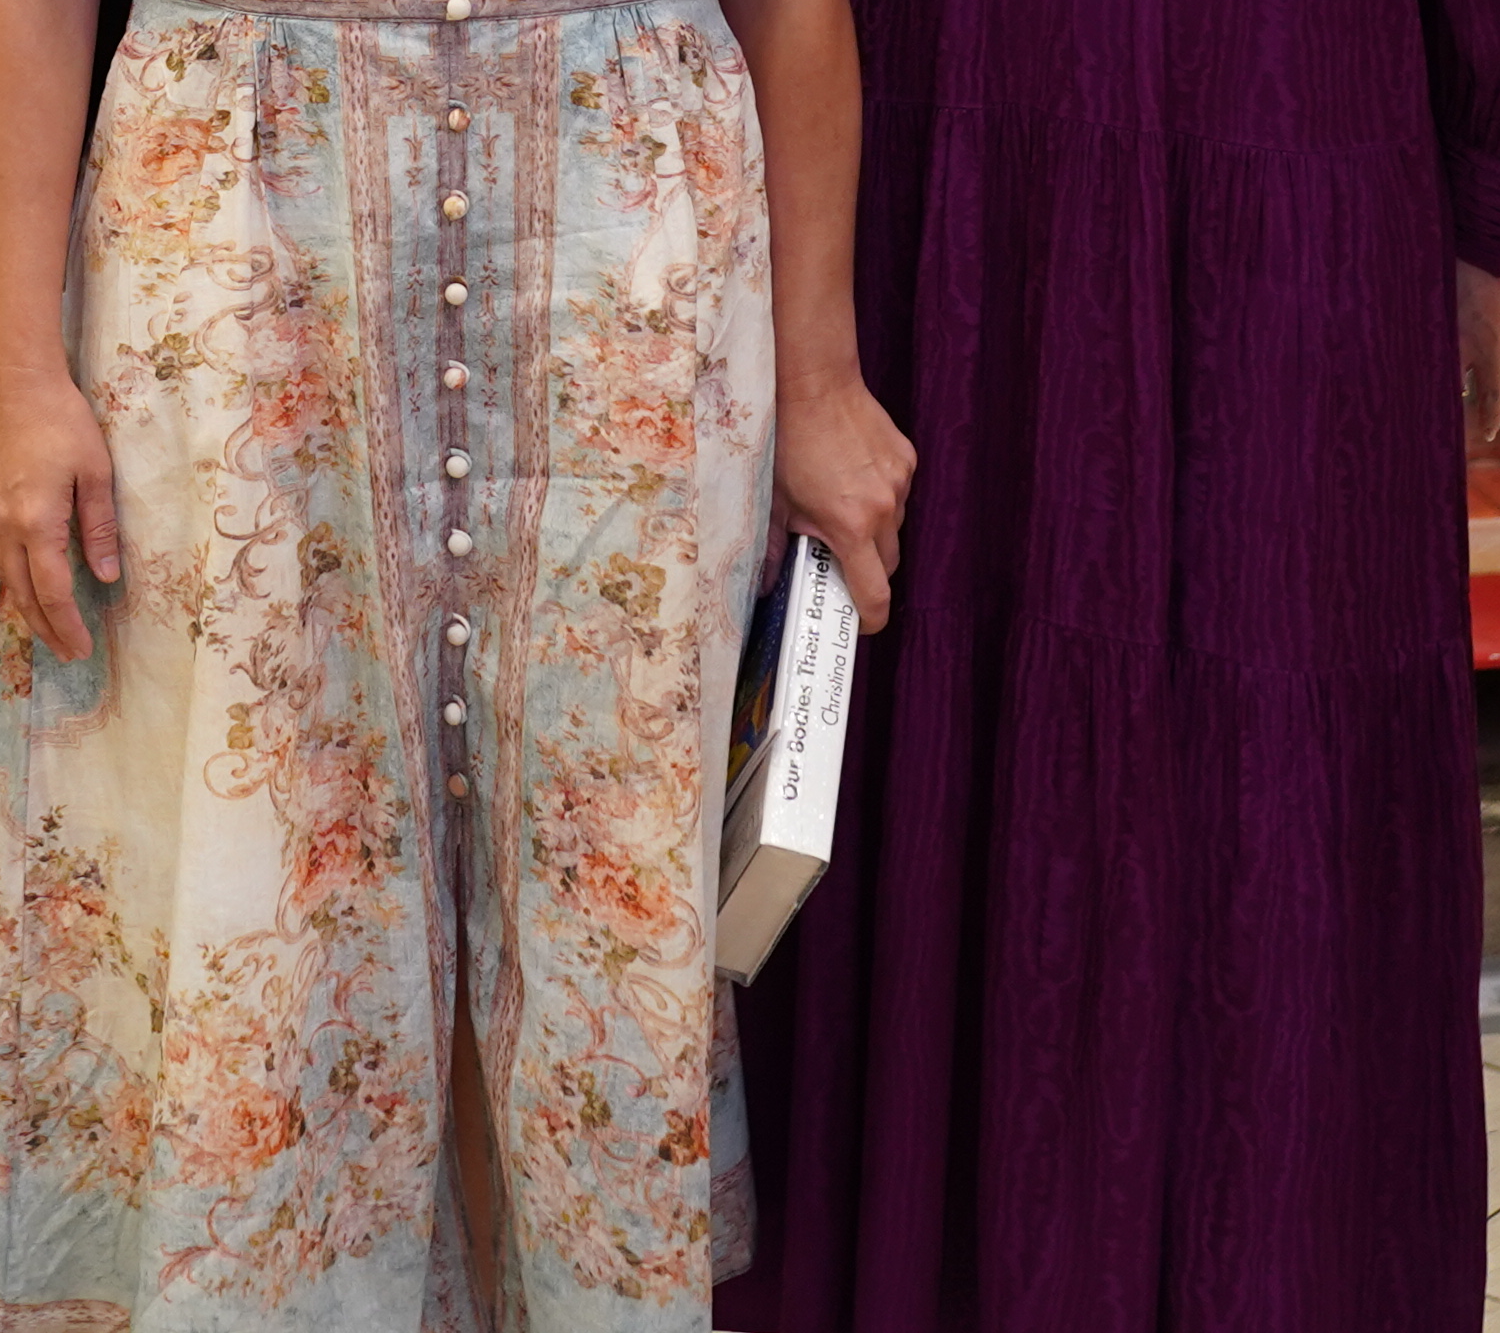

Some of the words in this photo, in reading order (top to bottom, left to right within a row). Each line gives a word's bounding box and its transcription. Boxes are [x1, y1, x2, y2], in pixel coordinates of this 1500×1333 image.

[806, 542, 832, 621] Battlefi
[796, 629, 820, 677] Their
[833, 604, 853, 650] Lamb
[790, 683, 813, 752] Bodies
[821, 652, 846, 726] Christina
[784, 760, 801, 801] Our
